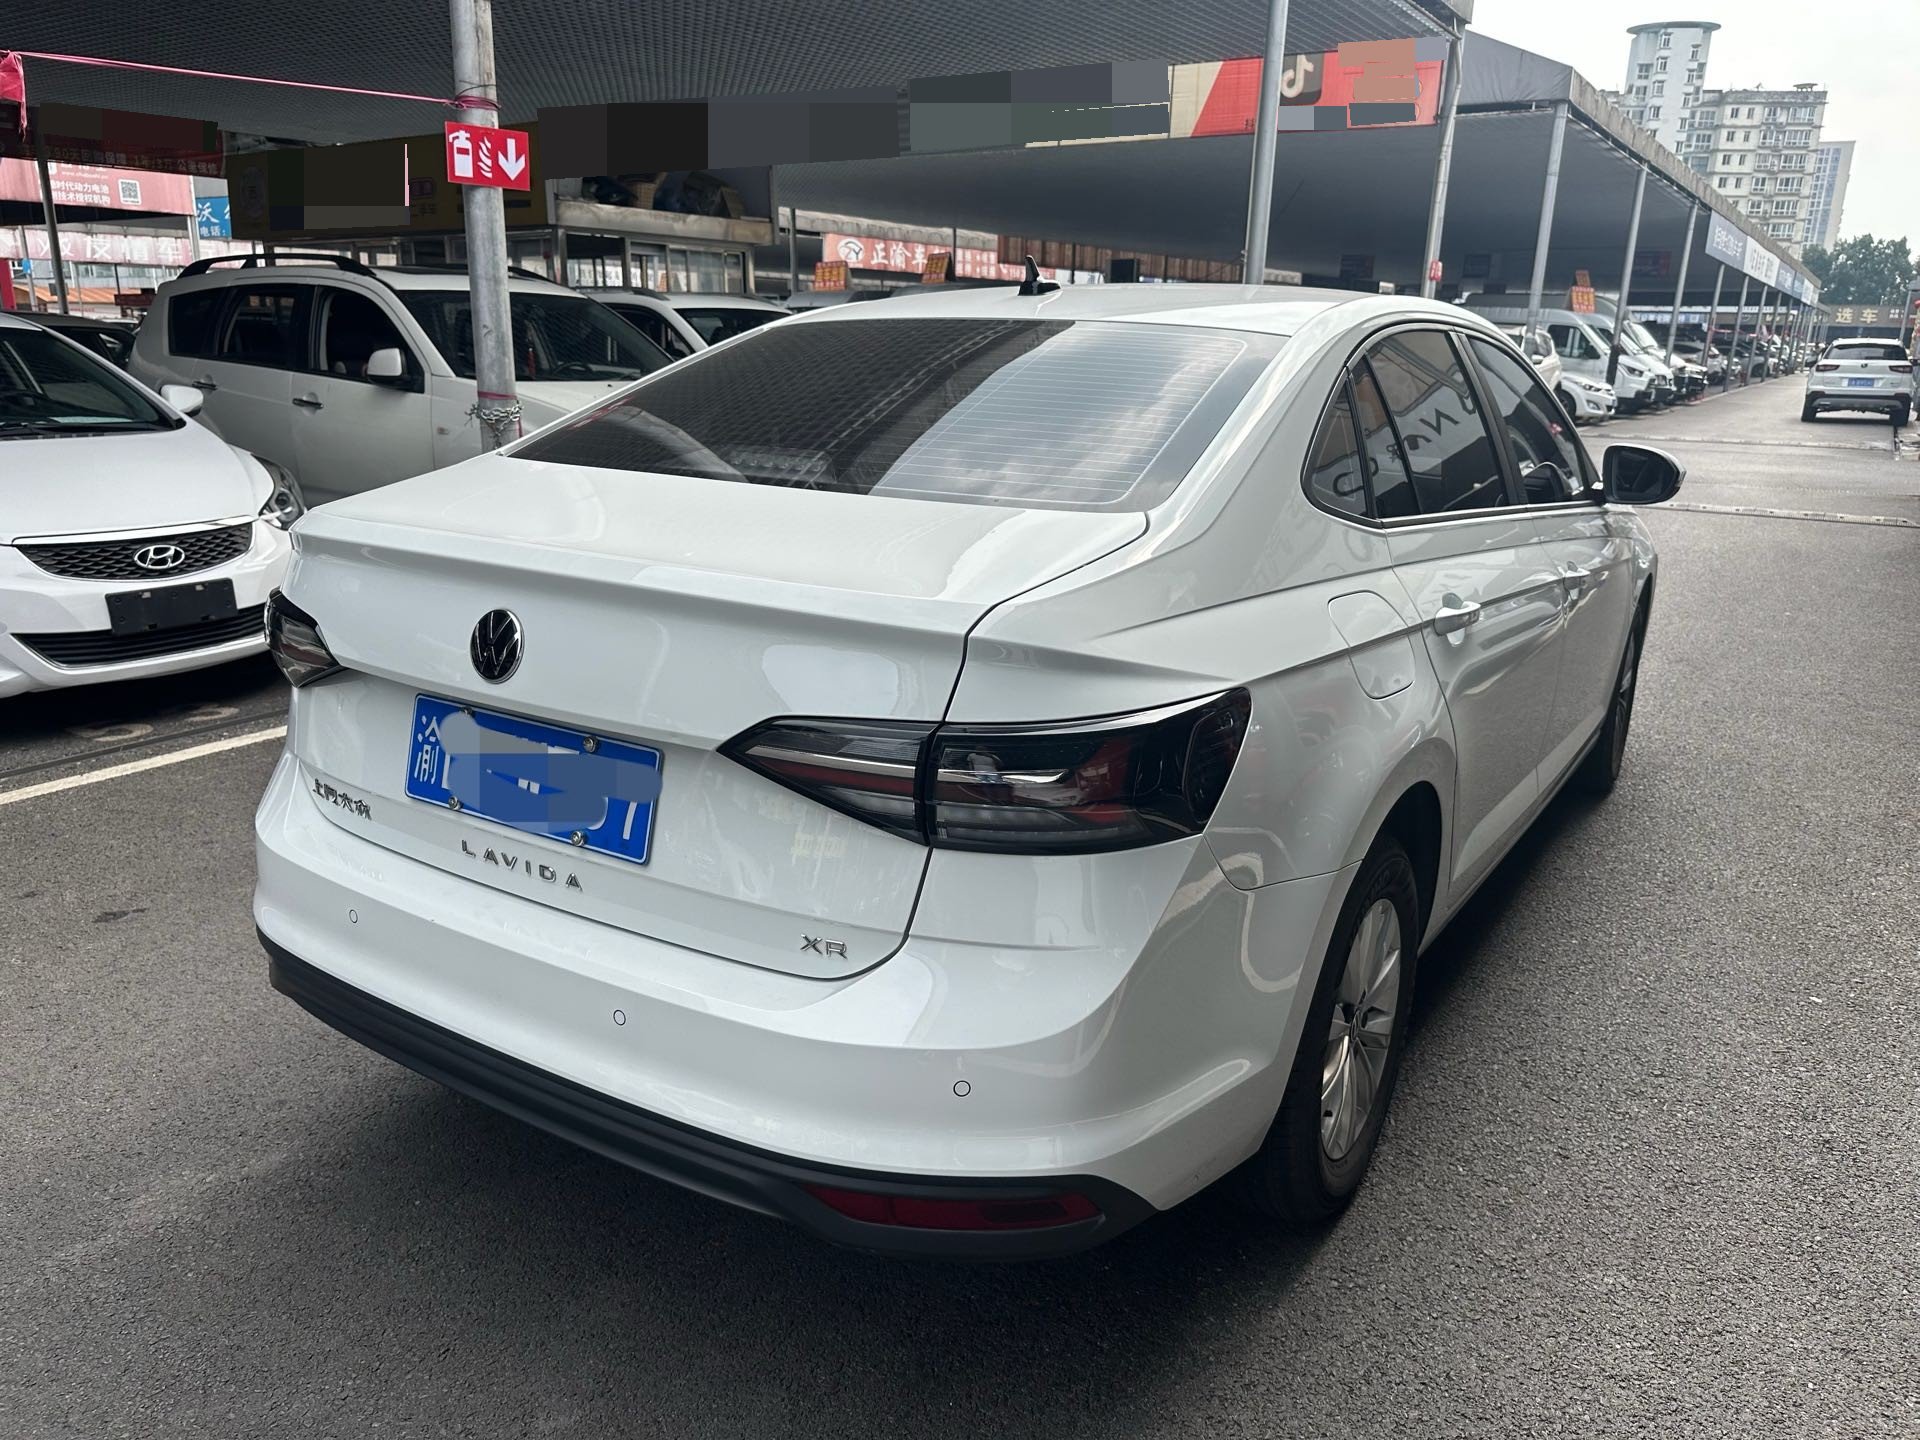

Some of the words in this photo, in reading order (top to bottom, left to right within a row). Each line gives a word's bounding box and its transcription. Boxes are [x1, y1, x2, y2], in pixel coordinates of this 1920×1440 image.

[870, 241, 945, 273] 正渝车
[461, 839, 584, 893] LAVIDA
[800, 933, 848, 960] XR
